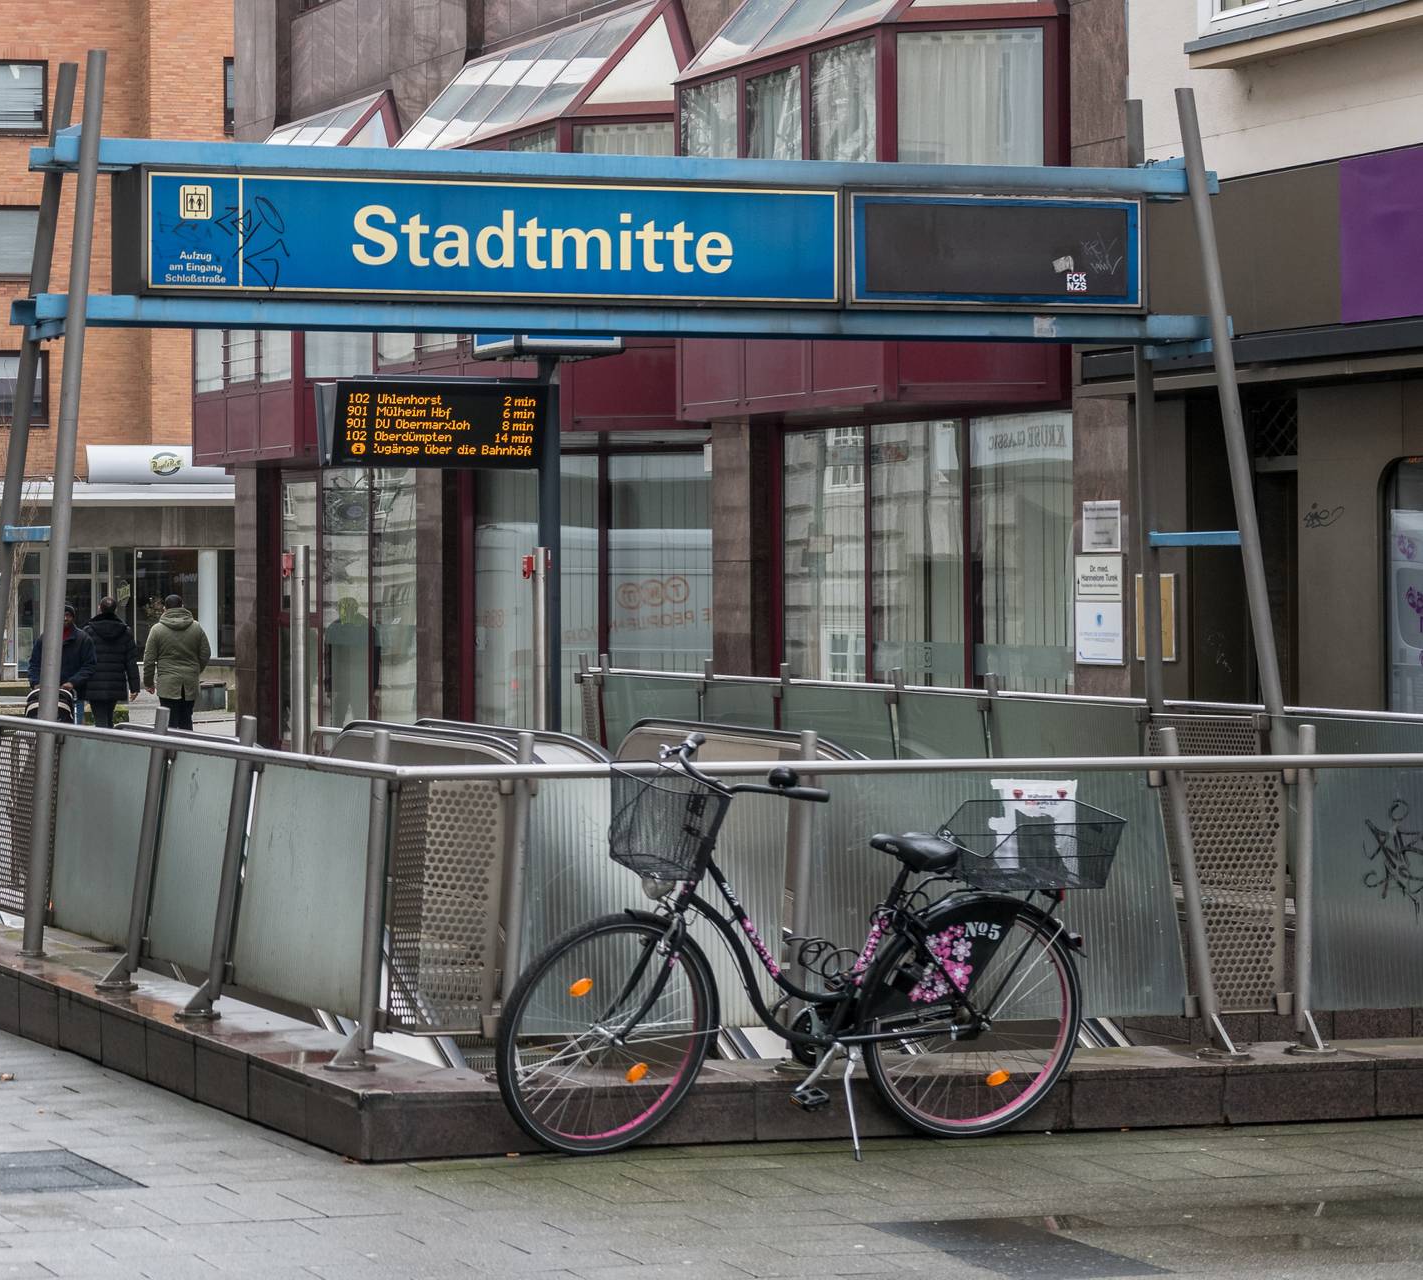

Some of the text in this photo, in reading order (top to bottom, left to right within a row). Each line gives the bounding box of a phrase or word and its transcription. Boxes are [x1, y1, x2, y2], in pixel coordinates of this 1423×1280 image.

[353, 204, 733, 274] Stadtmitte
[179, 251, 212, 262] Aufzug
[186, 263, 222, 273] Eingang
[165, 274, 226, 283] Schloßstraße
[1066, 273, 1087, 282] FCK
[1066, 282, 1087, 291] NZS
[349, 394, 536, 407] 102 Uhlenhorst 2 min
[347, 406, 535, 420] 901 Mülheim Hbf 6 min
[346, 419, 534, 432] 901 DU Obermarxloh 8 min
[346, 431, 533, 444] 102 Oberdümpten 14 min
[425, 444, 452, 455] über
[457, 444, 476, 455] die
